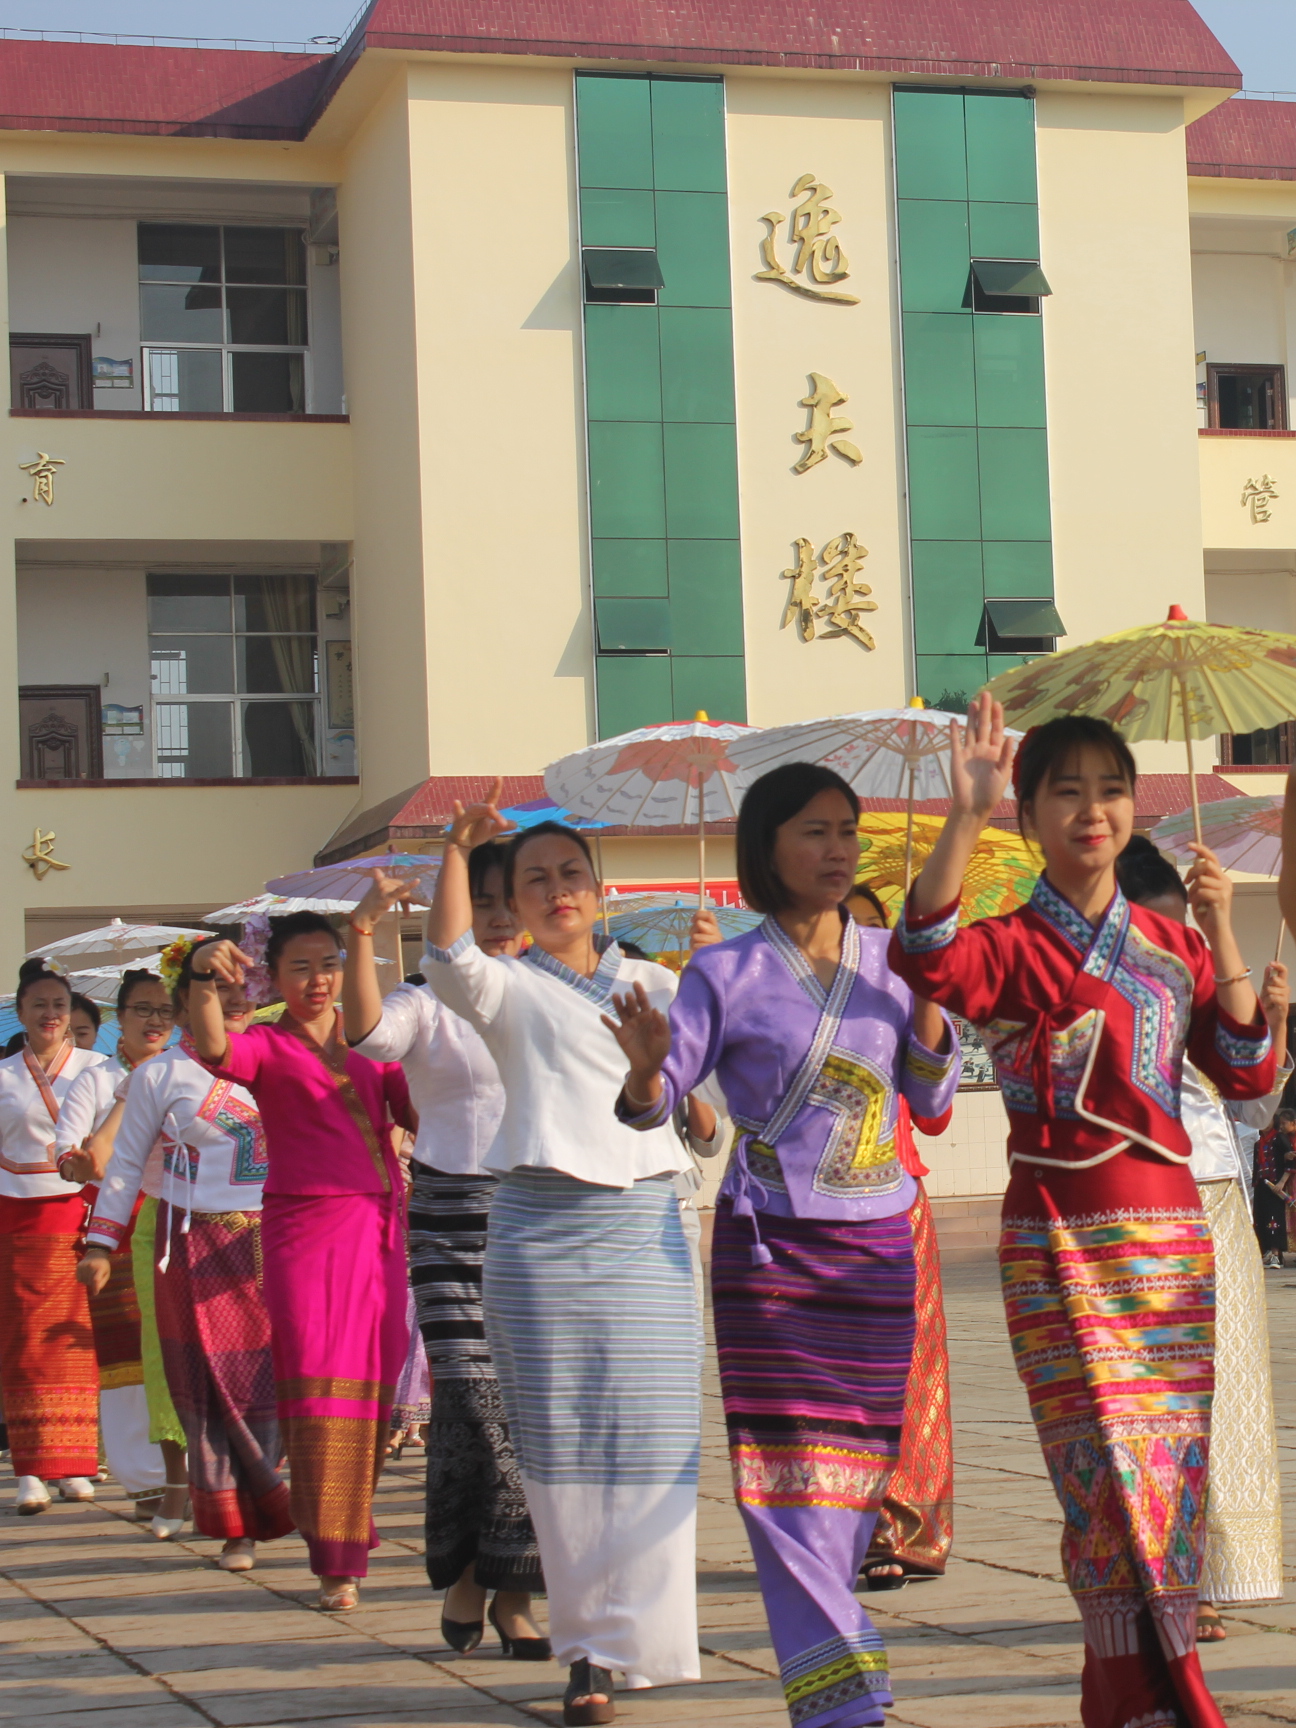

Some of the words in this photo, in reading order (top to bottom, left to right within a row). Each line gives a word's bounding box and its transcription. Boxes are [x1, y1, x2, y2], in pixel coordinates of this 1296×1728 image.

[19, 451, 66, 506] 育
[752, 173, 879, 652] 逸夫楼
